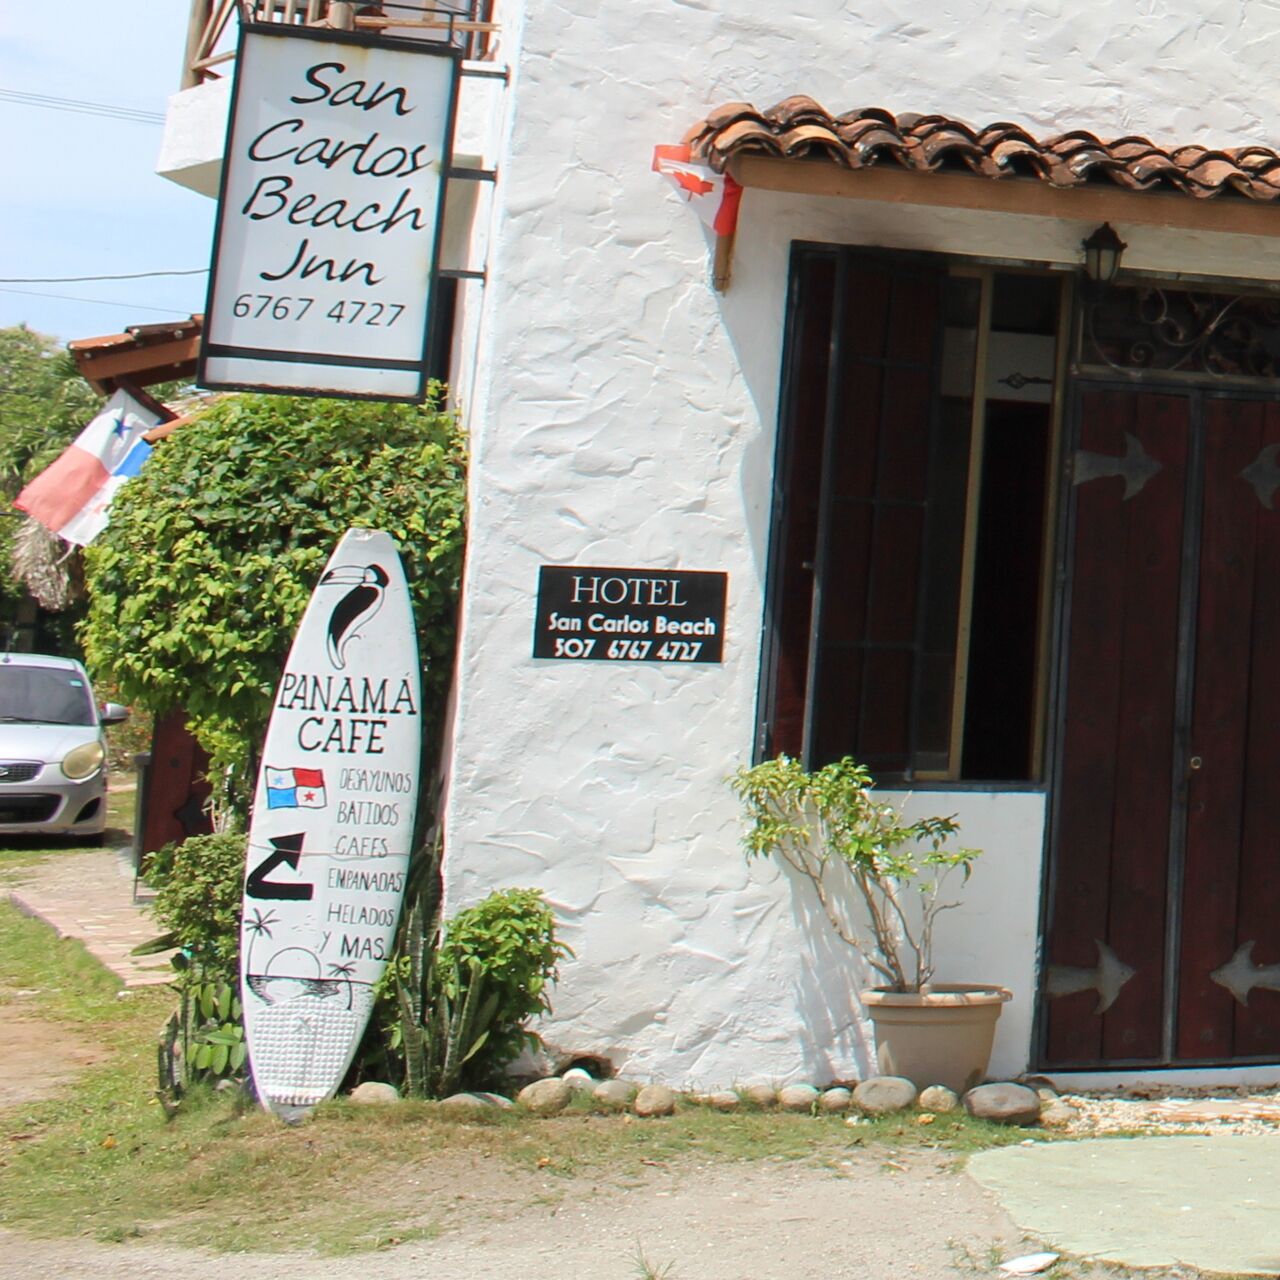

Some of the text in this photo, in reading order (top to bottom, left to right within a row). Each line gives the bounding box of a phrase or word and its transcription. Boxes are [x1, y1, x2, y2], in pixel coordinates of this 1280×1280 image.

[291, 62, 416, 116] San
[248, 119, 433, 178] Carlos
[242, 176, 427, 234] Beach
[260, 239, 385, 286] Inn
[233, 294, 405, 327] 6767 4727
[571, 576, 687, 606] HOTEL
[548, 613, 715, 636] San Carlos Beach
[555, 638, 702, 661] 507 6767 4727
[340, 767, 412, 793] DESAYUNOS
[337, 801, 399, 826] BATIDOS
[335, 835, 388, 858] CAFES
[327, 902, 394, 927] HELADOS
